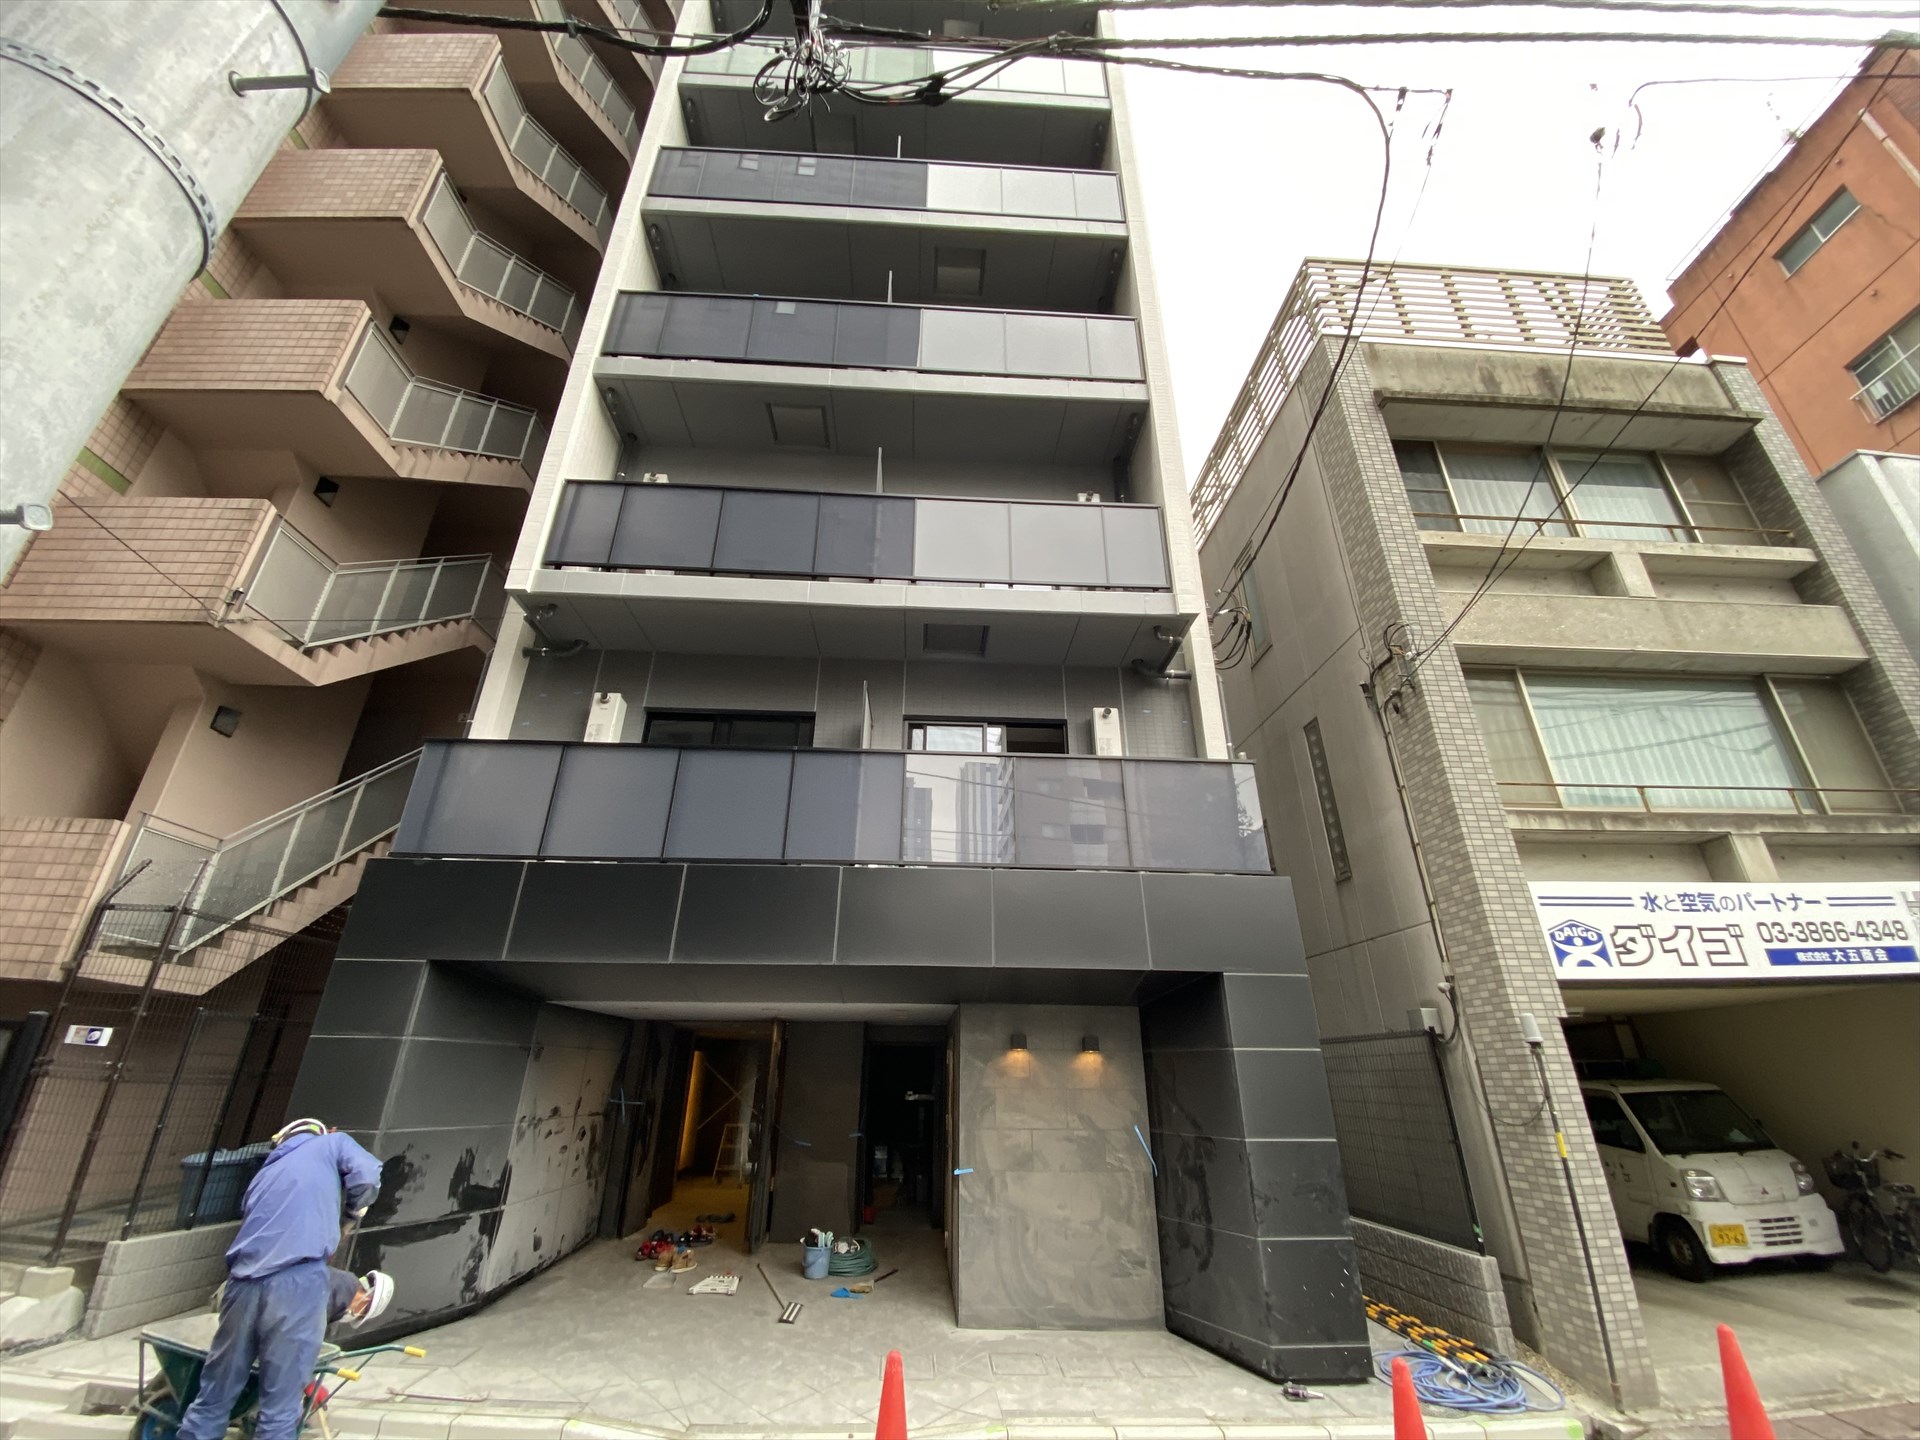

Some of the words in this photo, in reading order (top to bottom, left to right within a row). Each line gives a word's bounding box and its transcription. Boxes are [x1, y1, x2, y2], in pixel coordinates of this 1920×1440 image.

[1640, 891, 1821, 913] 水と空気のパートナー
[1553, 925, 1598, 942] DAIGO
[1756, 920, 1909, 944] 03-3866-4348
[1610, 923, 1748, 967] ダイゴ
